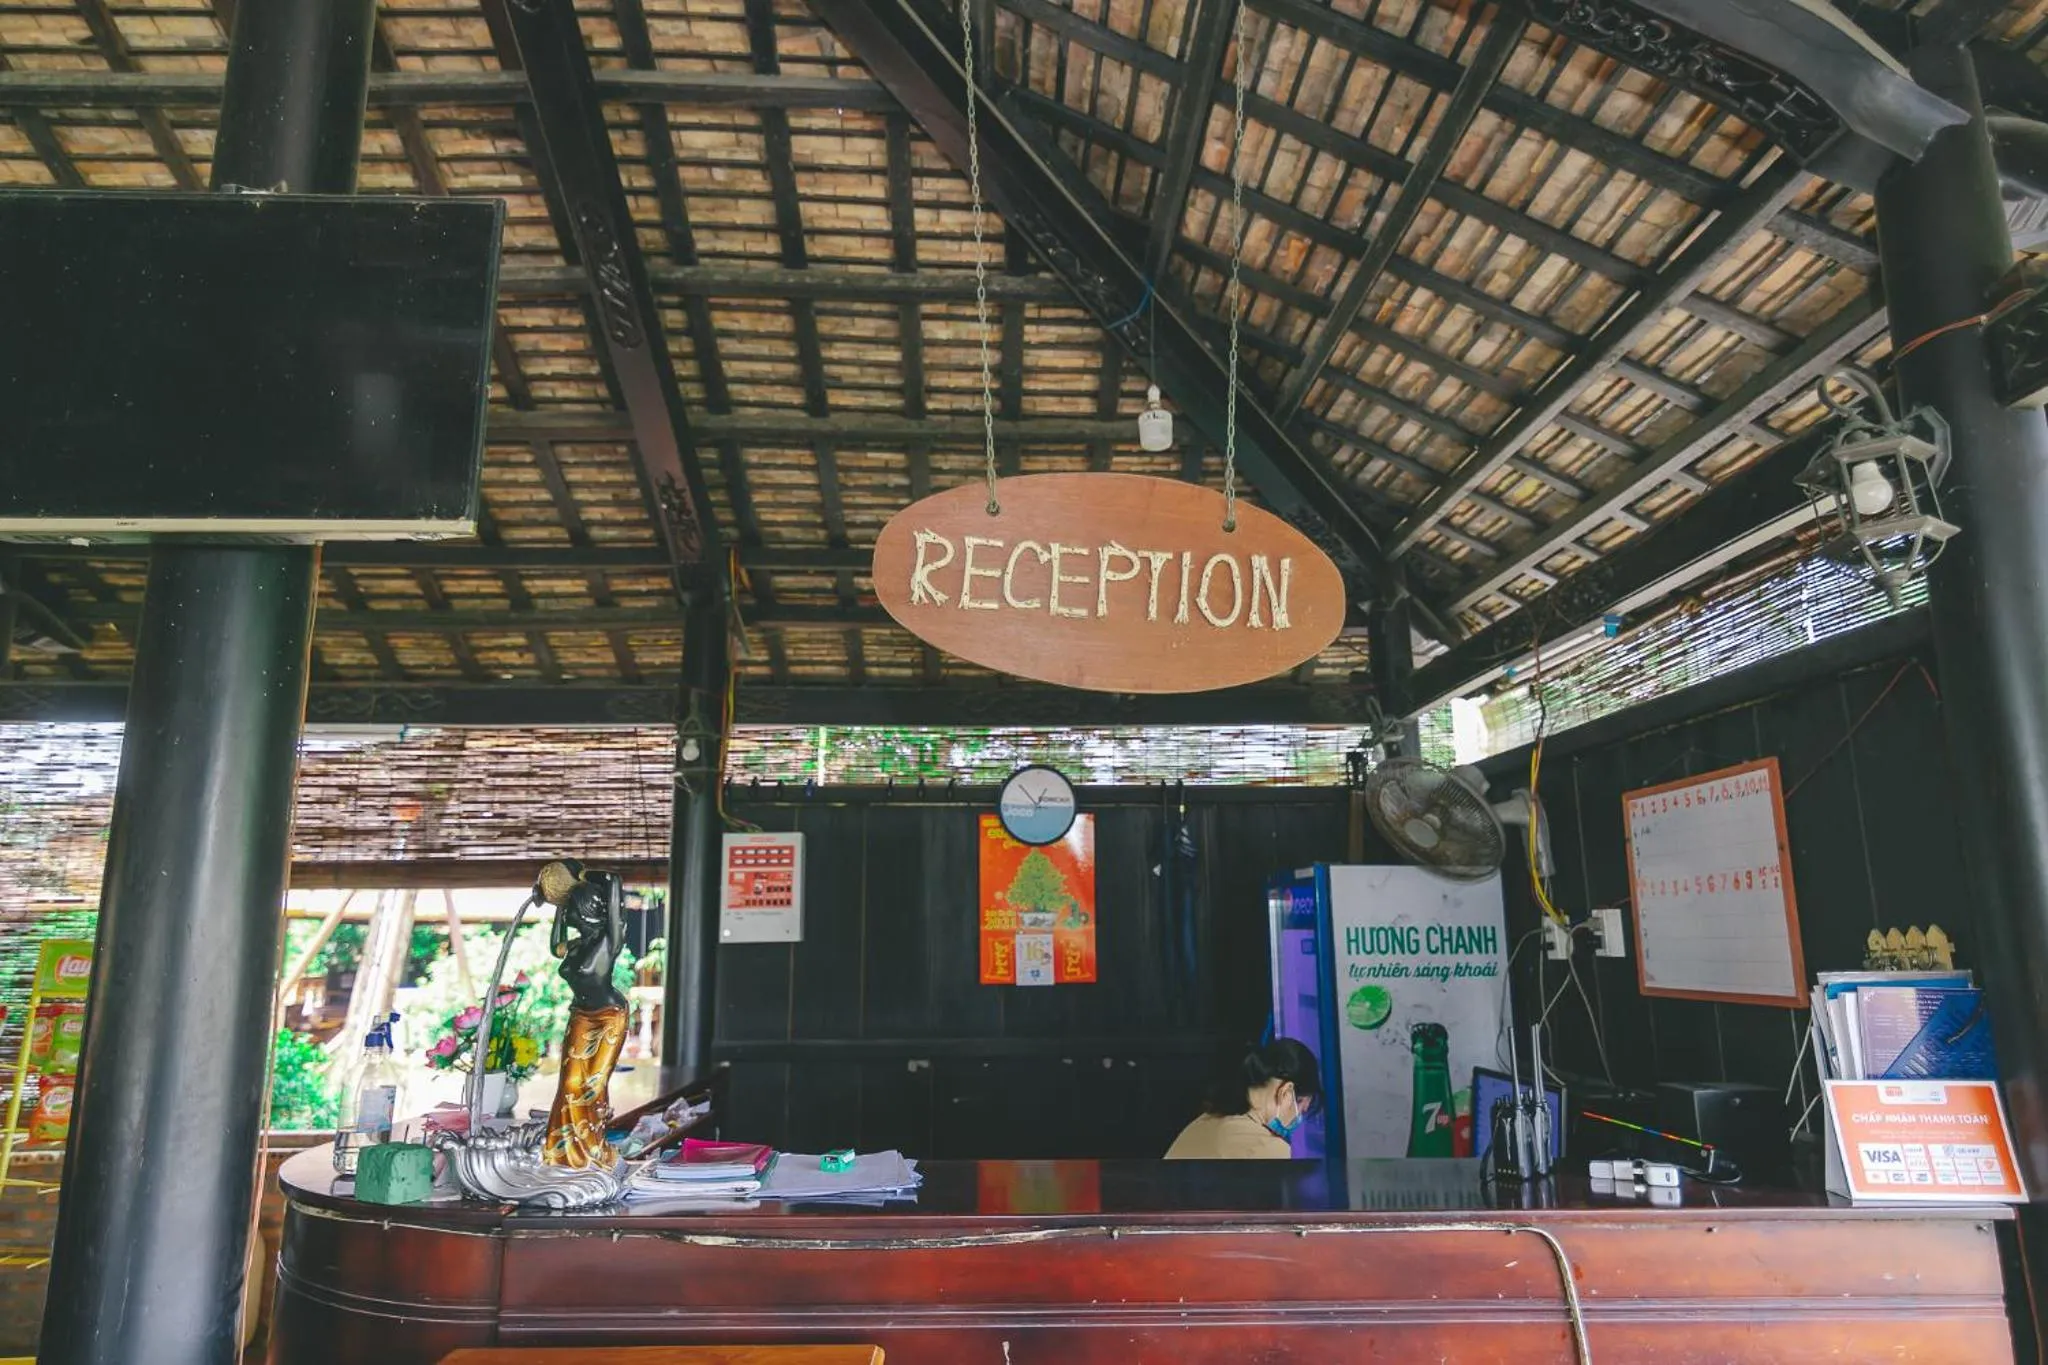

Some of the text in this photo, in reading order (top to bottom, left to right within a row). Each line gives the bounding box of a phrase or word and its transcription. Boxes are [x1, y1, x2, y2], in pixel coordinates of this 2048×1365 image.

[909, 527, 1292, 630] RECEPTION
[1425, 925, 1498, 956] CHANH
[1366, 962, 1412, 978] nhiên
[1413, 961, 1451, 983] sáng
[1453, 960, 1500, 978] khoái
[1918, 1112, 1957, 1125] THANH
[1863, 1149, 1902, 1163] VISA
